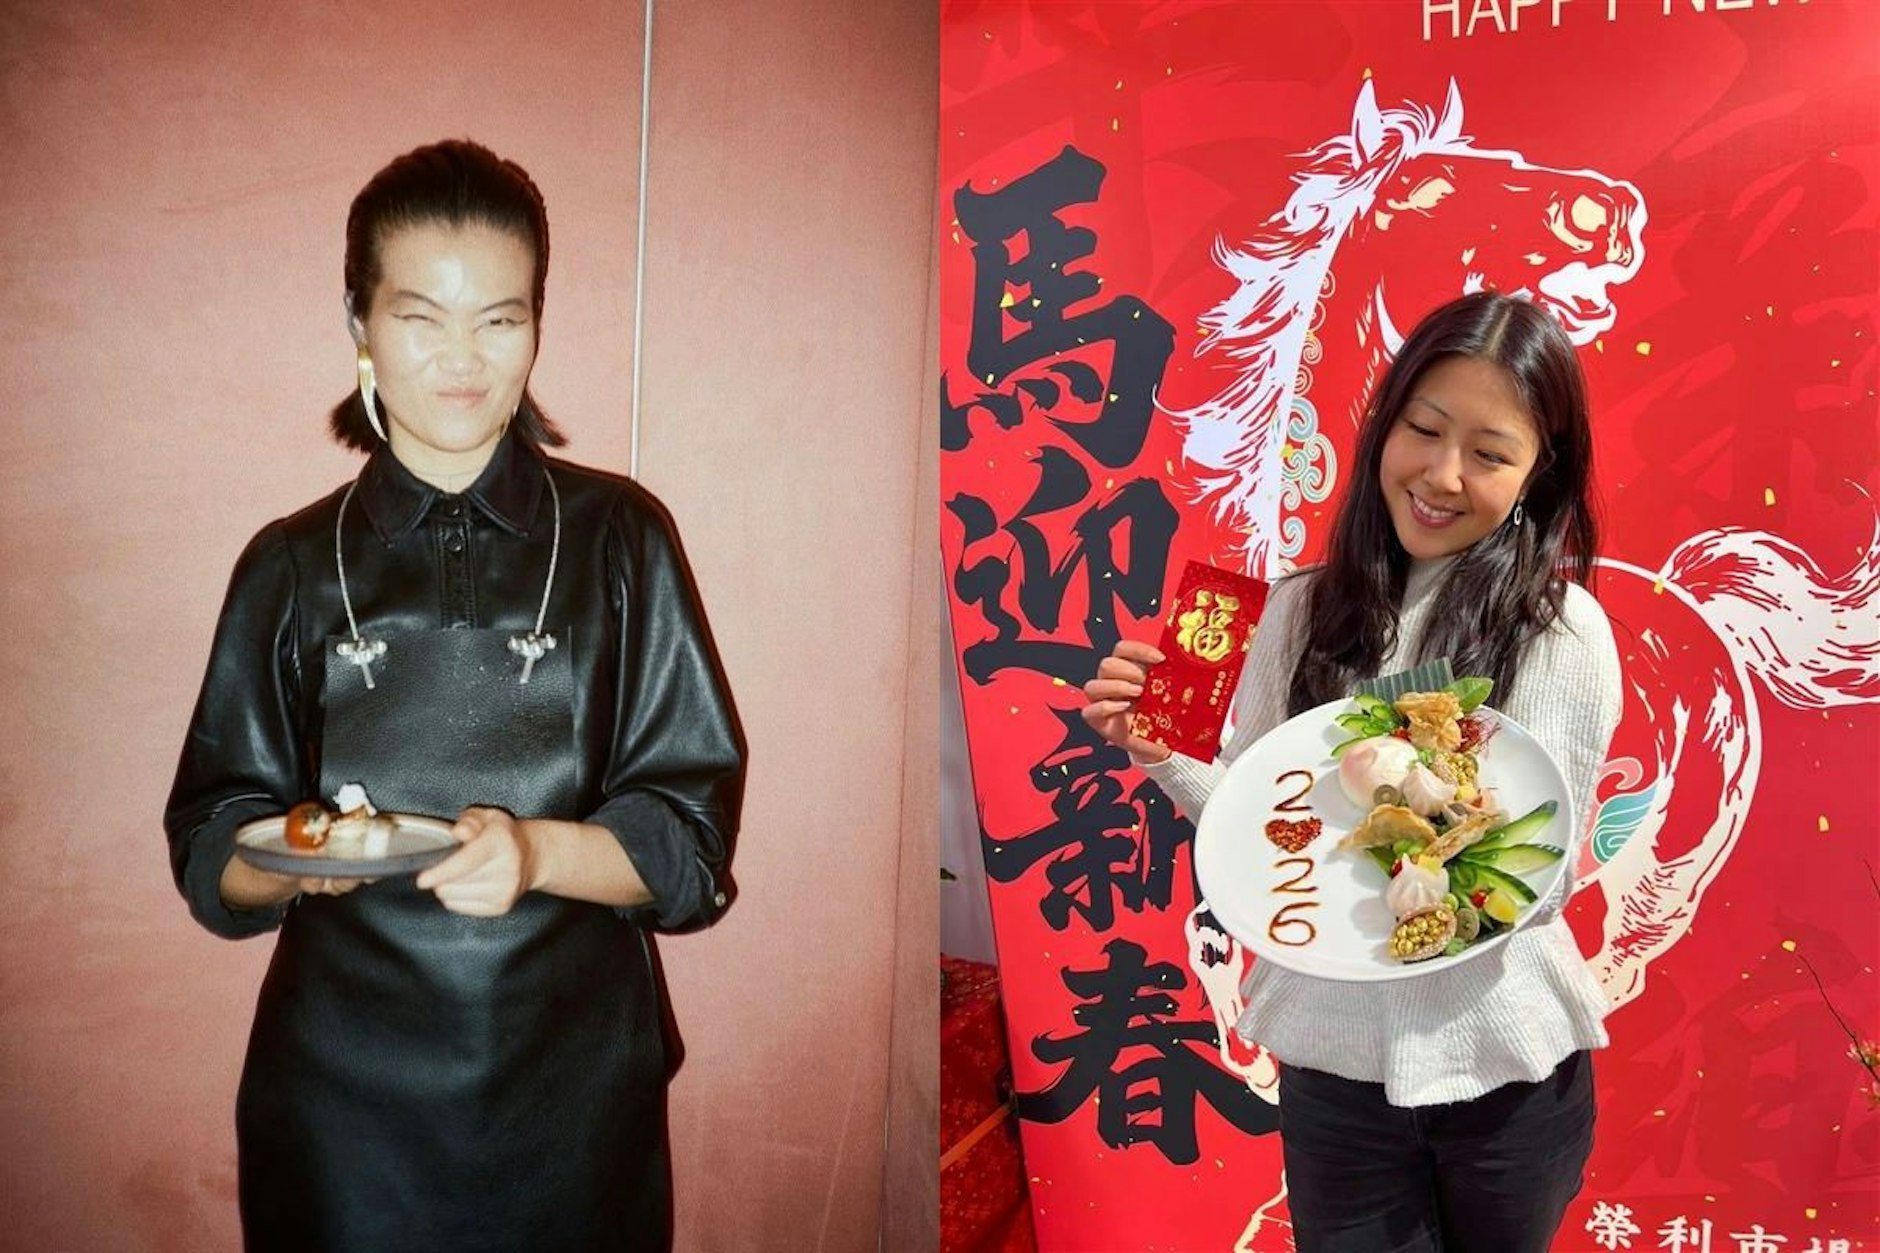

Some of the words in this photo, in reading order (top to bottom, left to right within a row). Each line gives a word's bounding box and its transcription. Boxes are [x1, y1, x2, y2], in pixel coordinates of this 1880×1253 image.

[940, 145, 1280, 1166] 馬迎新春
[1176, 589, 1241, 662] 福
